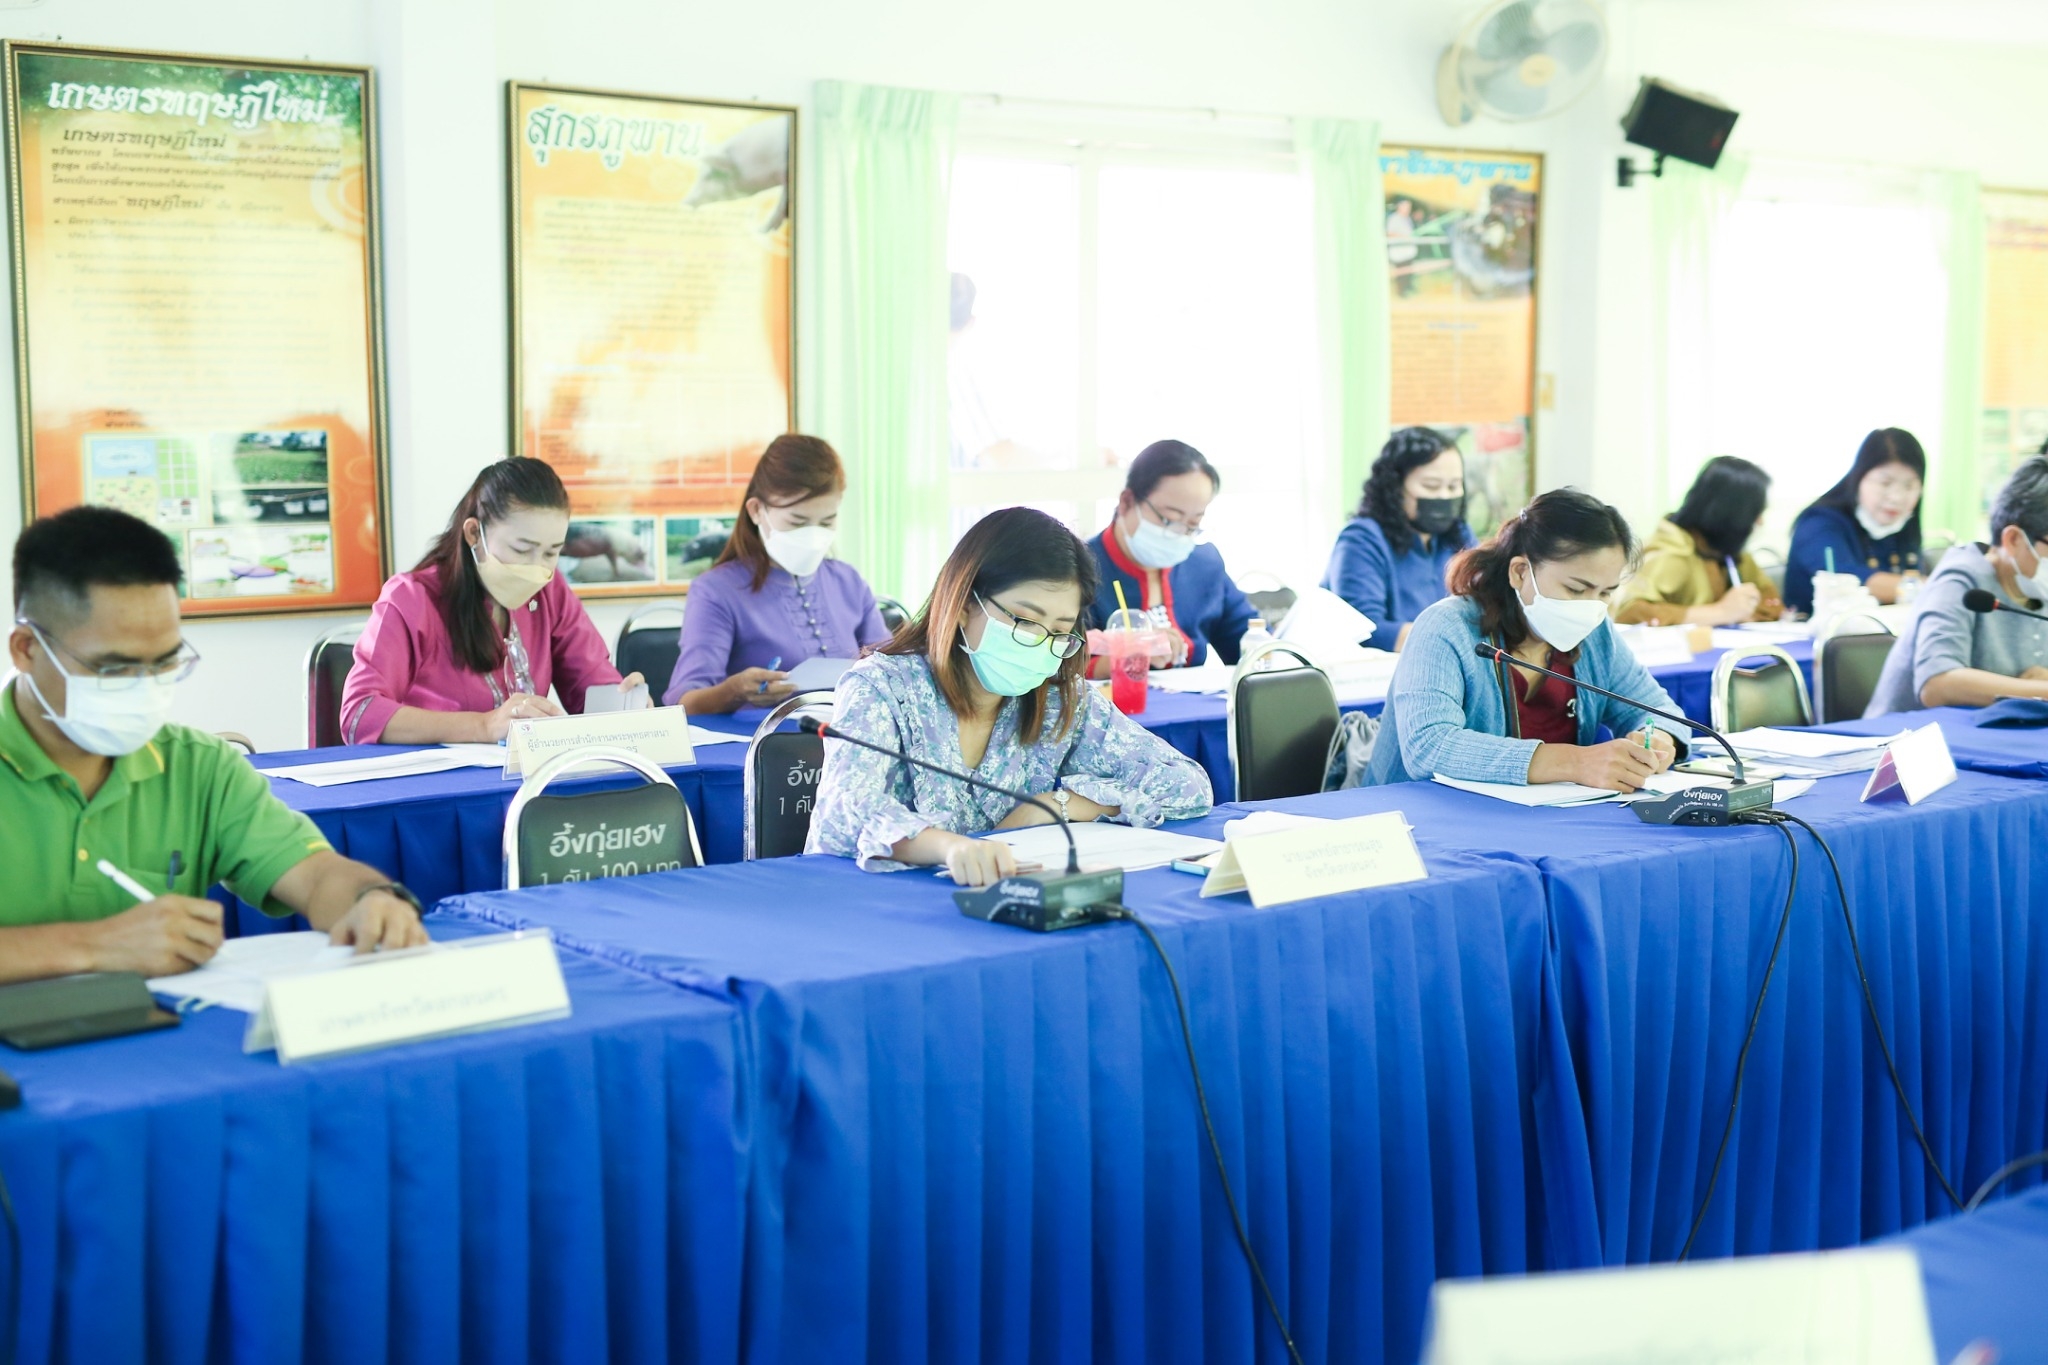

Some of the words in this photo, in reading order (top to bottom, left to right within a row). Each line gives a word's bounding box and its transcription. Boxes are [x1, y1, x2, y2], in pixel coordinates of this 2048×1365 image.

[528, 105, 703, 167] สุกรภูพาน
[527, 729, 670, 752] ผู้อำนวยการสำนักงานพระพุทธศาสนา
[778, 796, 785, 816] 1
[549, 822, 667, 858] อึ้งกุ่ยเฮง
